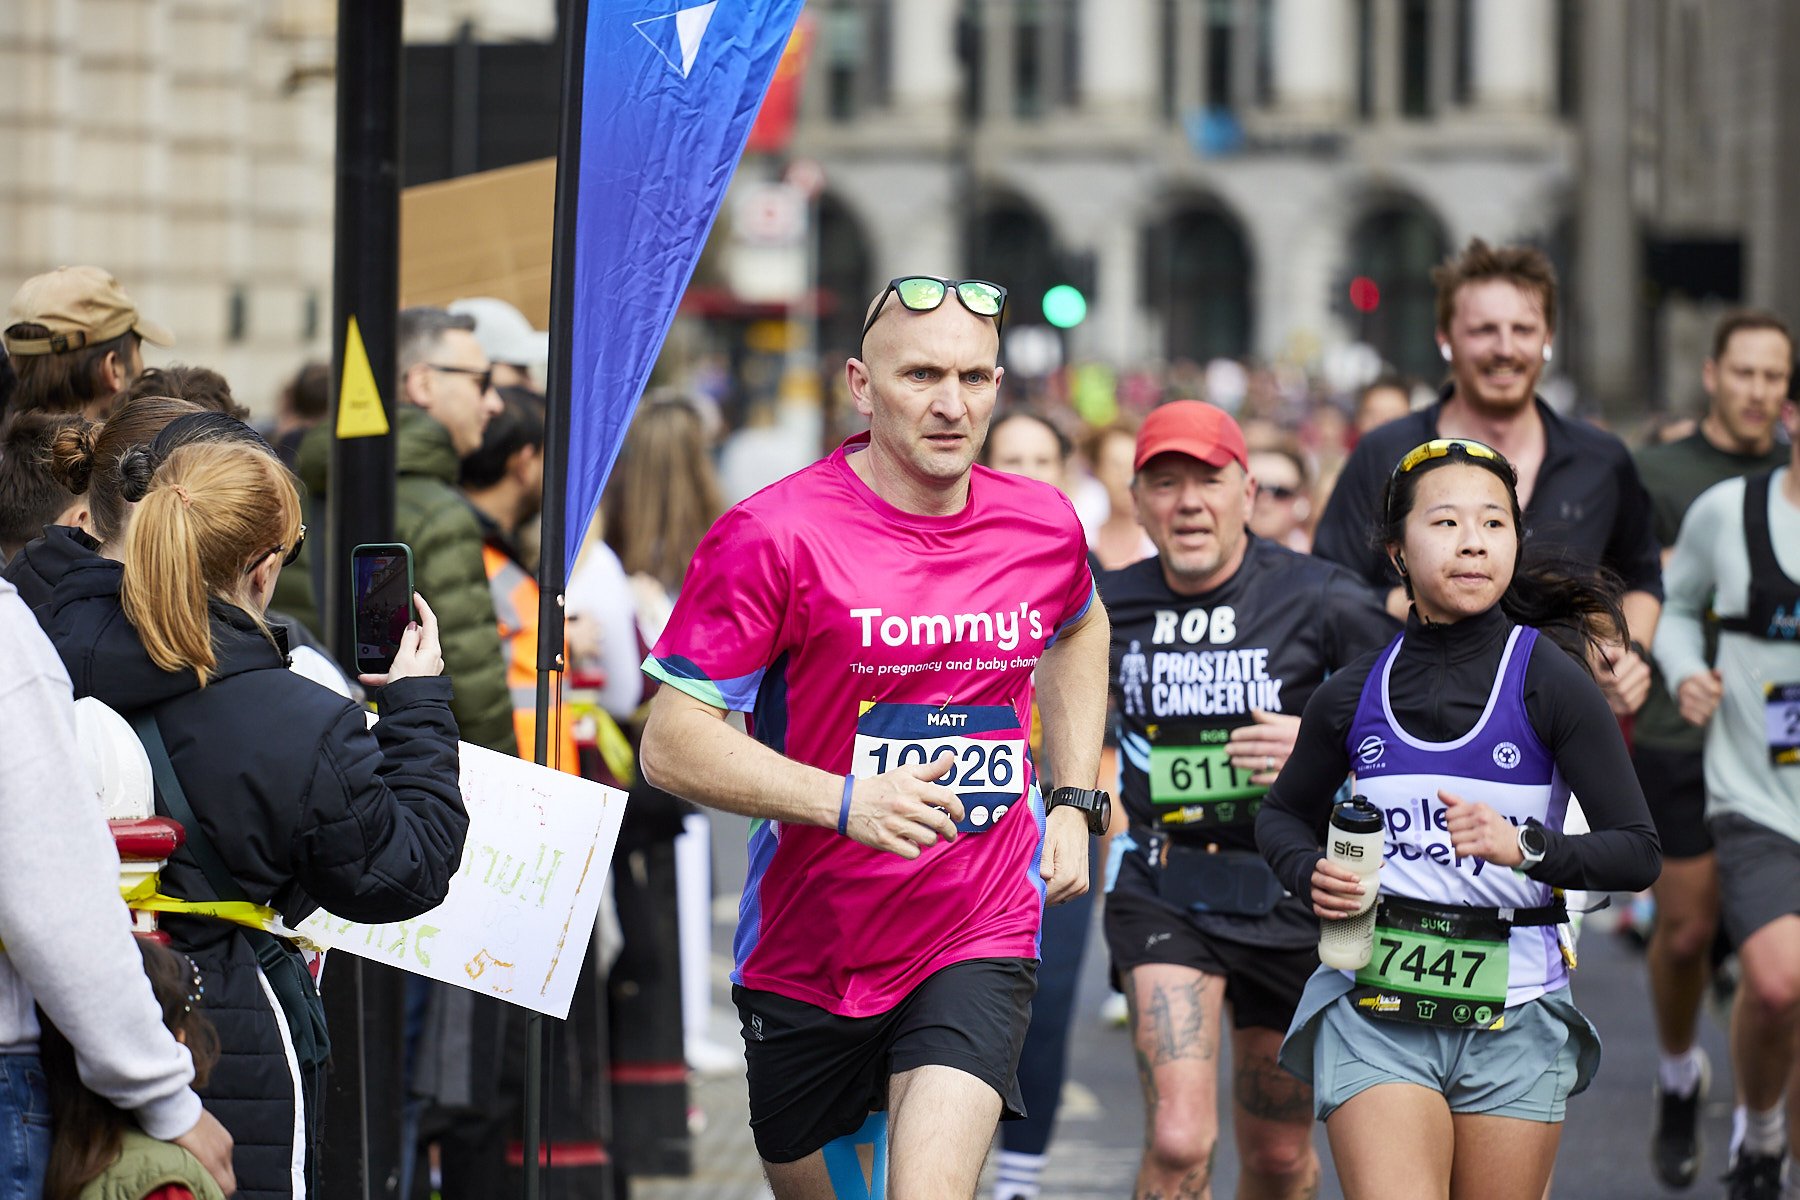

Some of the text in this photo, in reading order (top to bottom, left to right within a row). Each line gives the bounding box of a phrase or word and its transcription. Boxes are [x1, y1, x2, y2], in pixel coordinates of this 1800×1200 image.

[850, 602, 1043, 651] Tommy's
[1152, 605, 1237, 645] ROB
[850, 663, 875, 674] The
[878, 661, 942, 676] pregnancy
[946, 658, 973, 670] and
[976, 656, 1007, 671] baby
[1152, 648, 1270, 684] PROSTATE
[1152, 678, 1283, 717] CANCER UK
[927, 713, 968, 727] MATT
[1200, 730, 1229, 742] ROB
[1171, 757, 1254, 791] 611
[1421, 917, 1450, 932] SUKI
[1379, 938, 1486, 988] 7447
